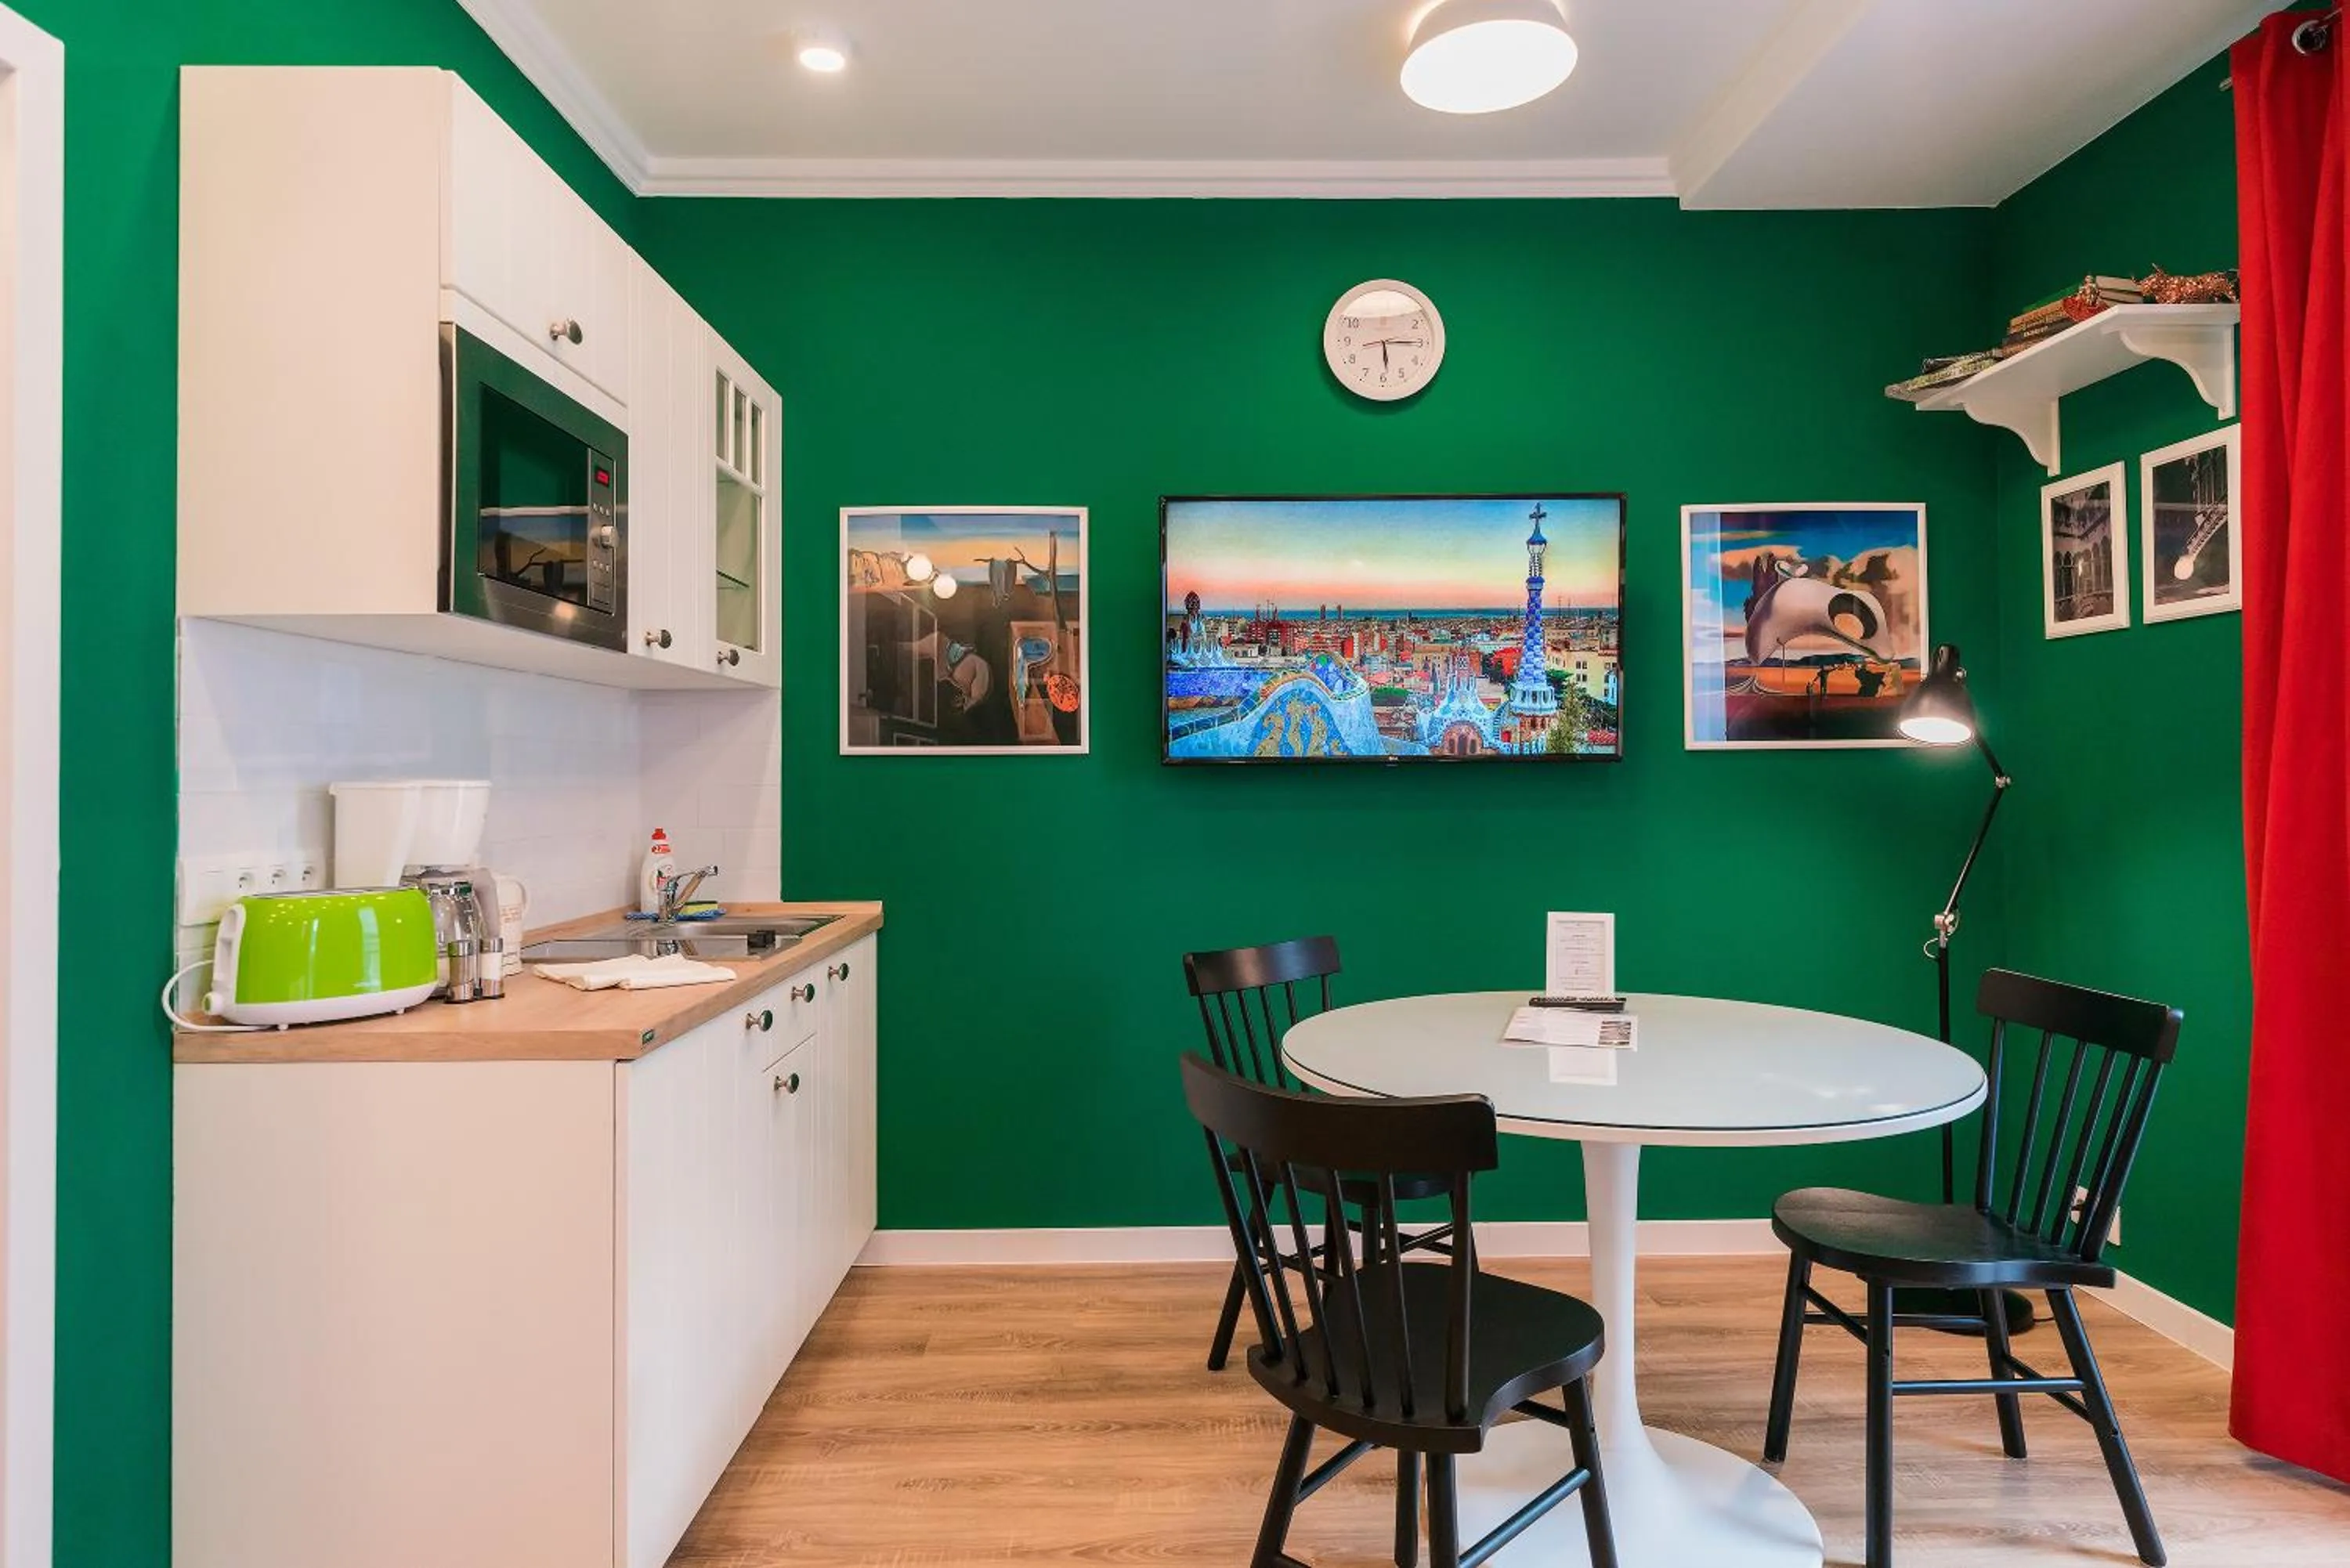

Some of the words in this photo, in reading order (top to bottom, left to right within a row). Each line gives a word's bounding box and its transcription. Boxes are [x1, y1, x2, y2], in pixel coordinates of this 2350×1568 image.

[1347, 318, 1359, 328] 10
[1412, 320, 1419, 329] 2
[1343, 337, 1351, 346] 9
[1418, 338, 1423, 348] 3
[1349, 354, 1356, 363] 8
[1362, 368, 1369, 377] 7
[1398, 368, 1405, 378] 5
[1379, 373, 1387, 382] 6
